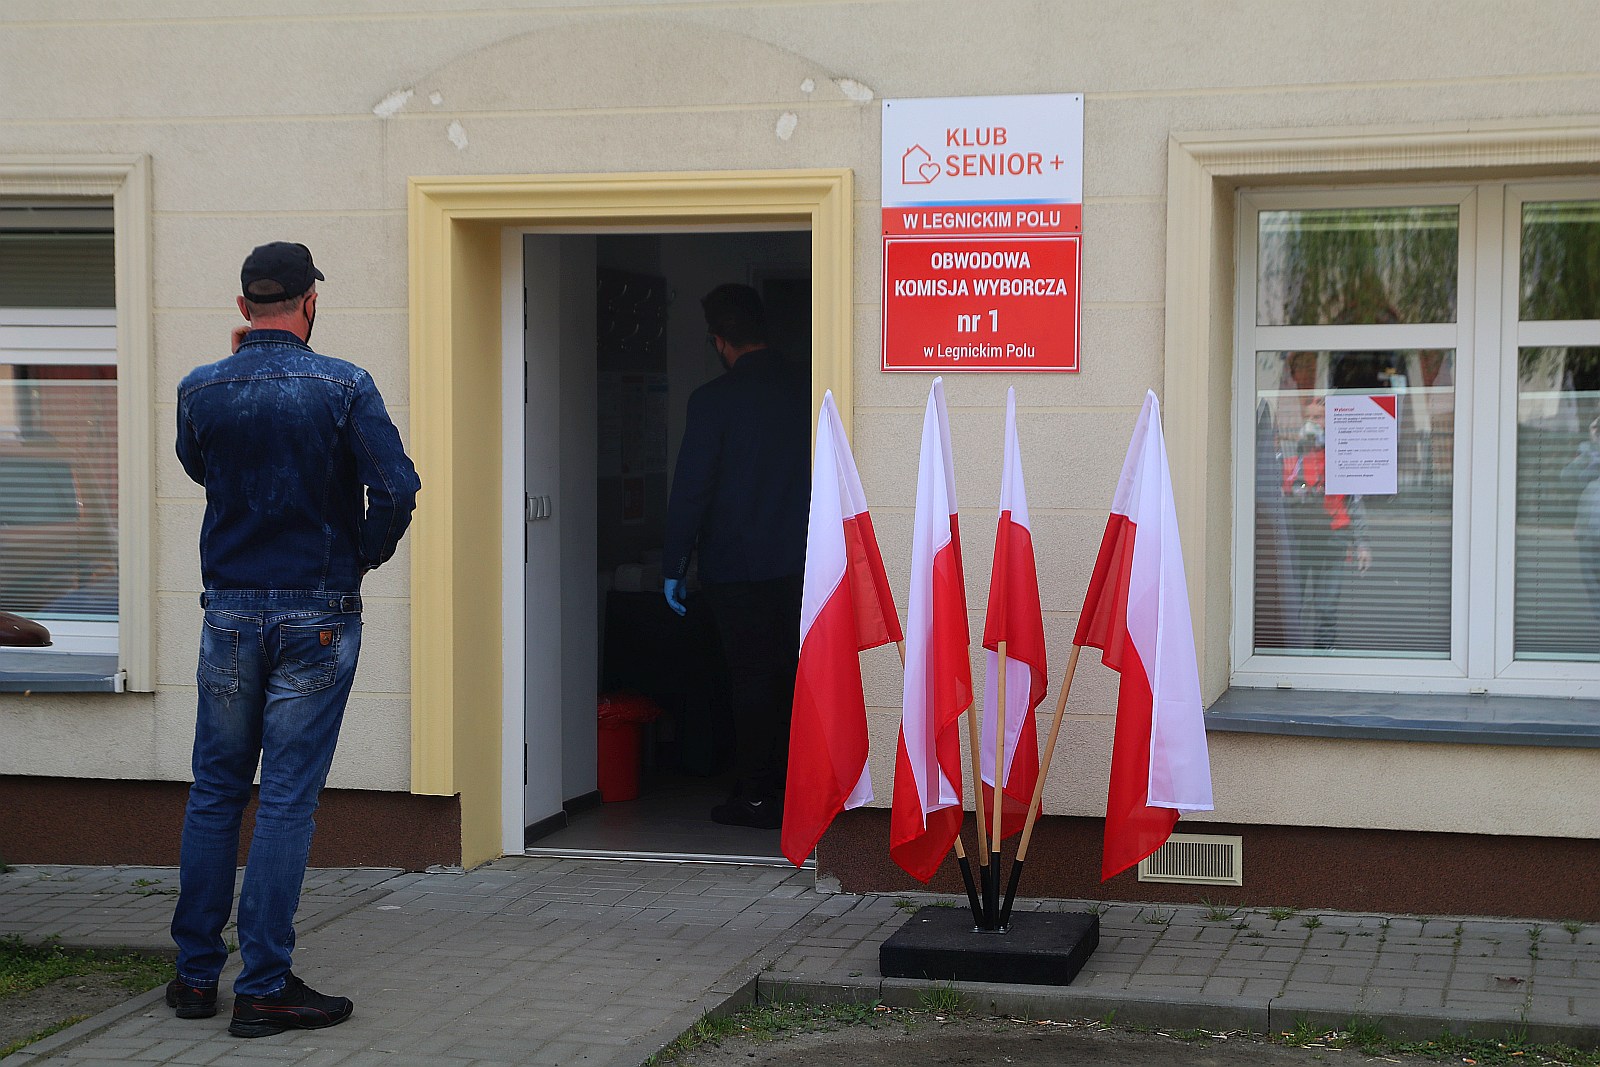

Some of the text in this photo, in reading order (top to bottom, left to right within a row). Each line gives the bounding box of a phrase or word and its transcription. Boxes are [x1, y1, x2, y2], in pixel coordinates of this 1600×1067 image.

[946, 127, 1007, 147] KLUB
[946, 153, 1042, 176] SENIOR
[903, 211, 1060, 229] W LEGNICKIM POLU
[931, 252, 1030, 269] OBWODOWA
[895, 278, 1067, 296] KOMISJA WYBORCZA
[957, 309, 998, 332] nr 1
[923, 343, 1035, 360] w Legnickim Polu
